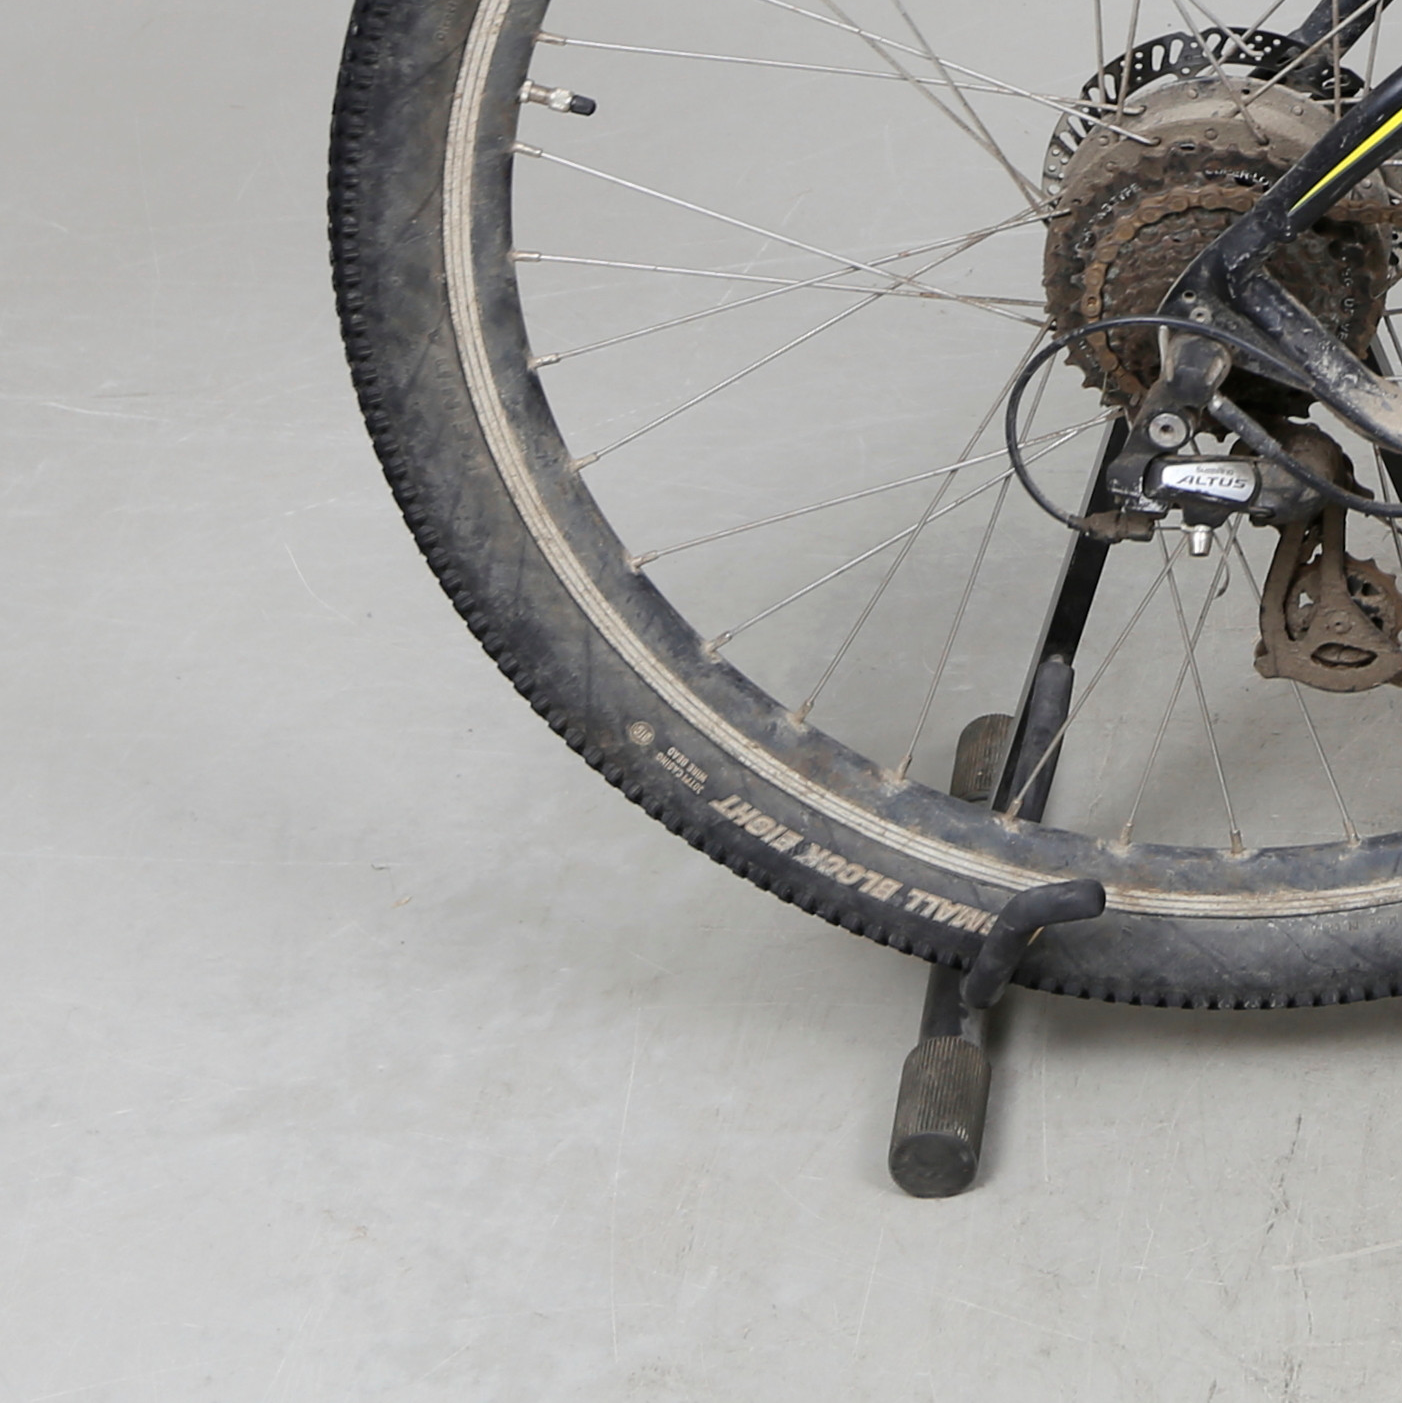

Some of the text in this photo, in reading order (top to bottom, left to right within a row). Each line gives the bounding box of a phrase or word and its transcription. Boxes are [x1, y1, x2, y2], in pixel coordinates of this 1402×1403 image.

[1177, 475, 1249, 489] ALTUS
[655, 751, 684, 778] CASING
[686, 762, 709, 784] WIRE
[707, 794, 805, 853] EIGHT
[791, 842, 904, 902] BLOCK
